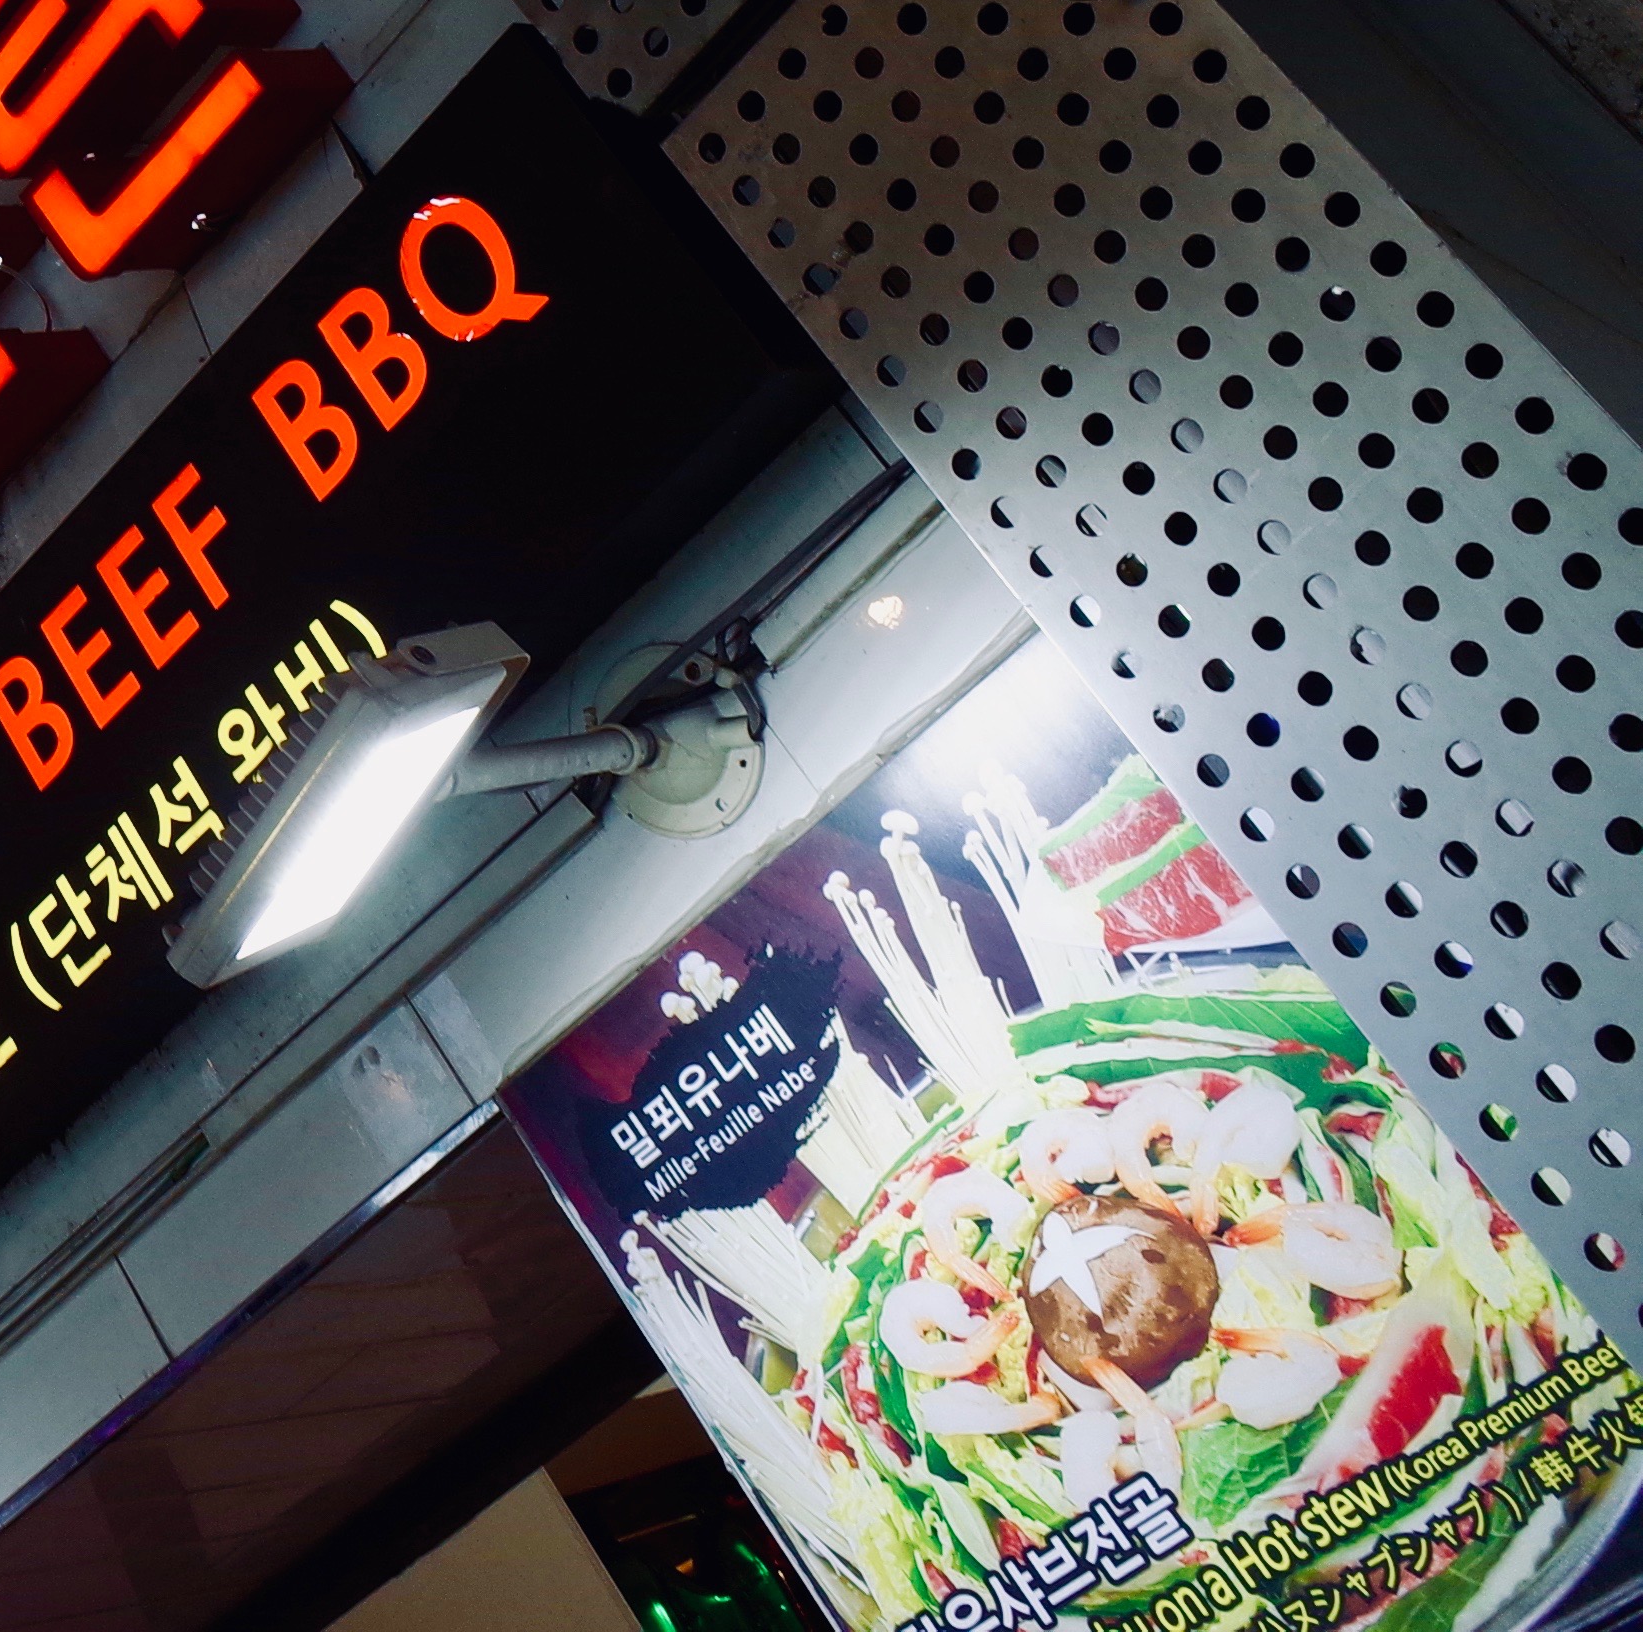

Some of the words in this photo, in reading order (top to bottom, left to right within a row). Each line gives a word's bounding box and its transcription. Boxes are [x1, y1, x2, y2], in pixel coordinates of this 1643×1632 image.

[252, 195, 550, 502] BBQ
[10, 757, 225, 1012] (단체석
[610, 1003, 796, 1169] 밀푀유나베
[643, 1104, 764, 1202] Mille-Feuille
[1150, 1587, 1200, 1629] on
[1199, 1570, 1236, 1608] a
[1232, 1522, 1309, 1591] Hot
[1392, 1440, 1468, 1506] (Korea
[1459, 1379, 1571, 1454] Premium
